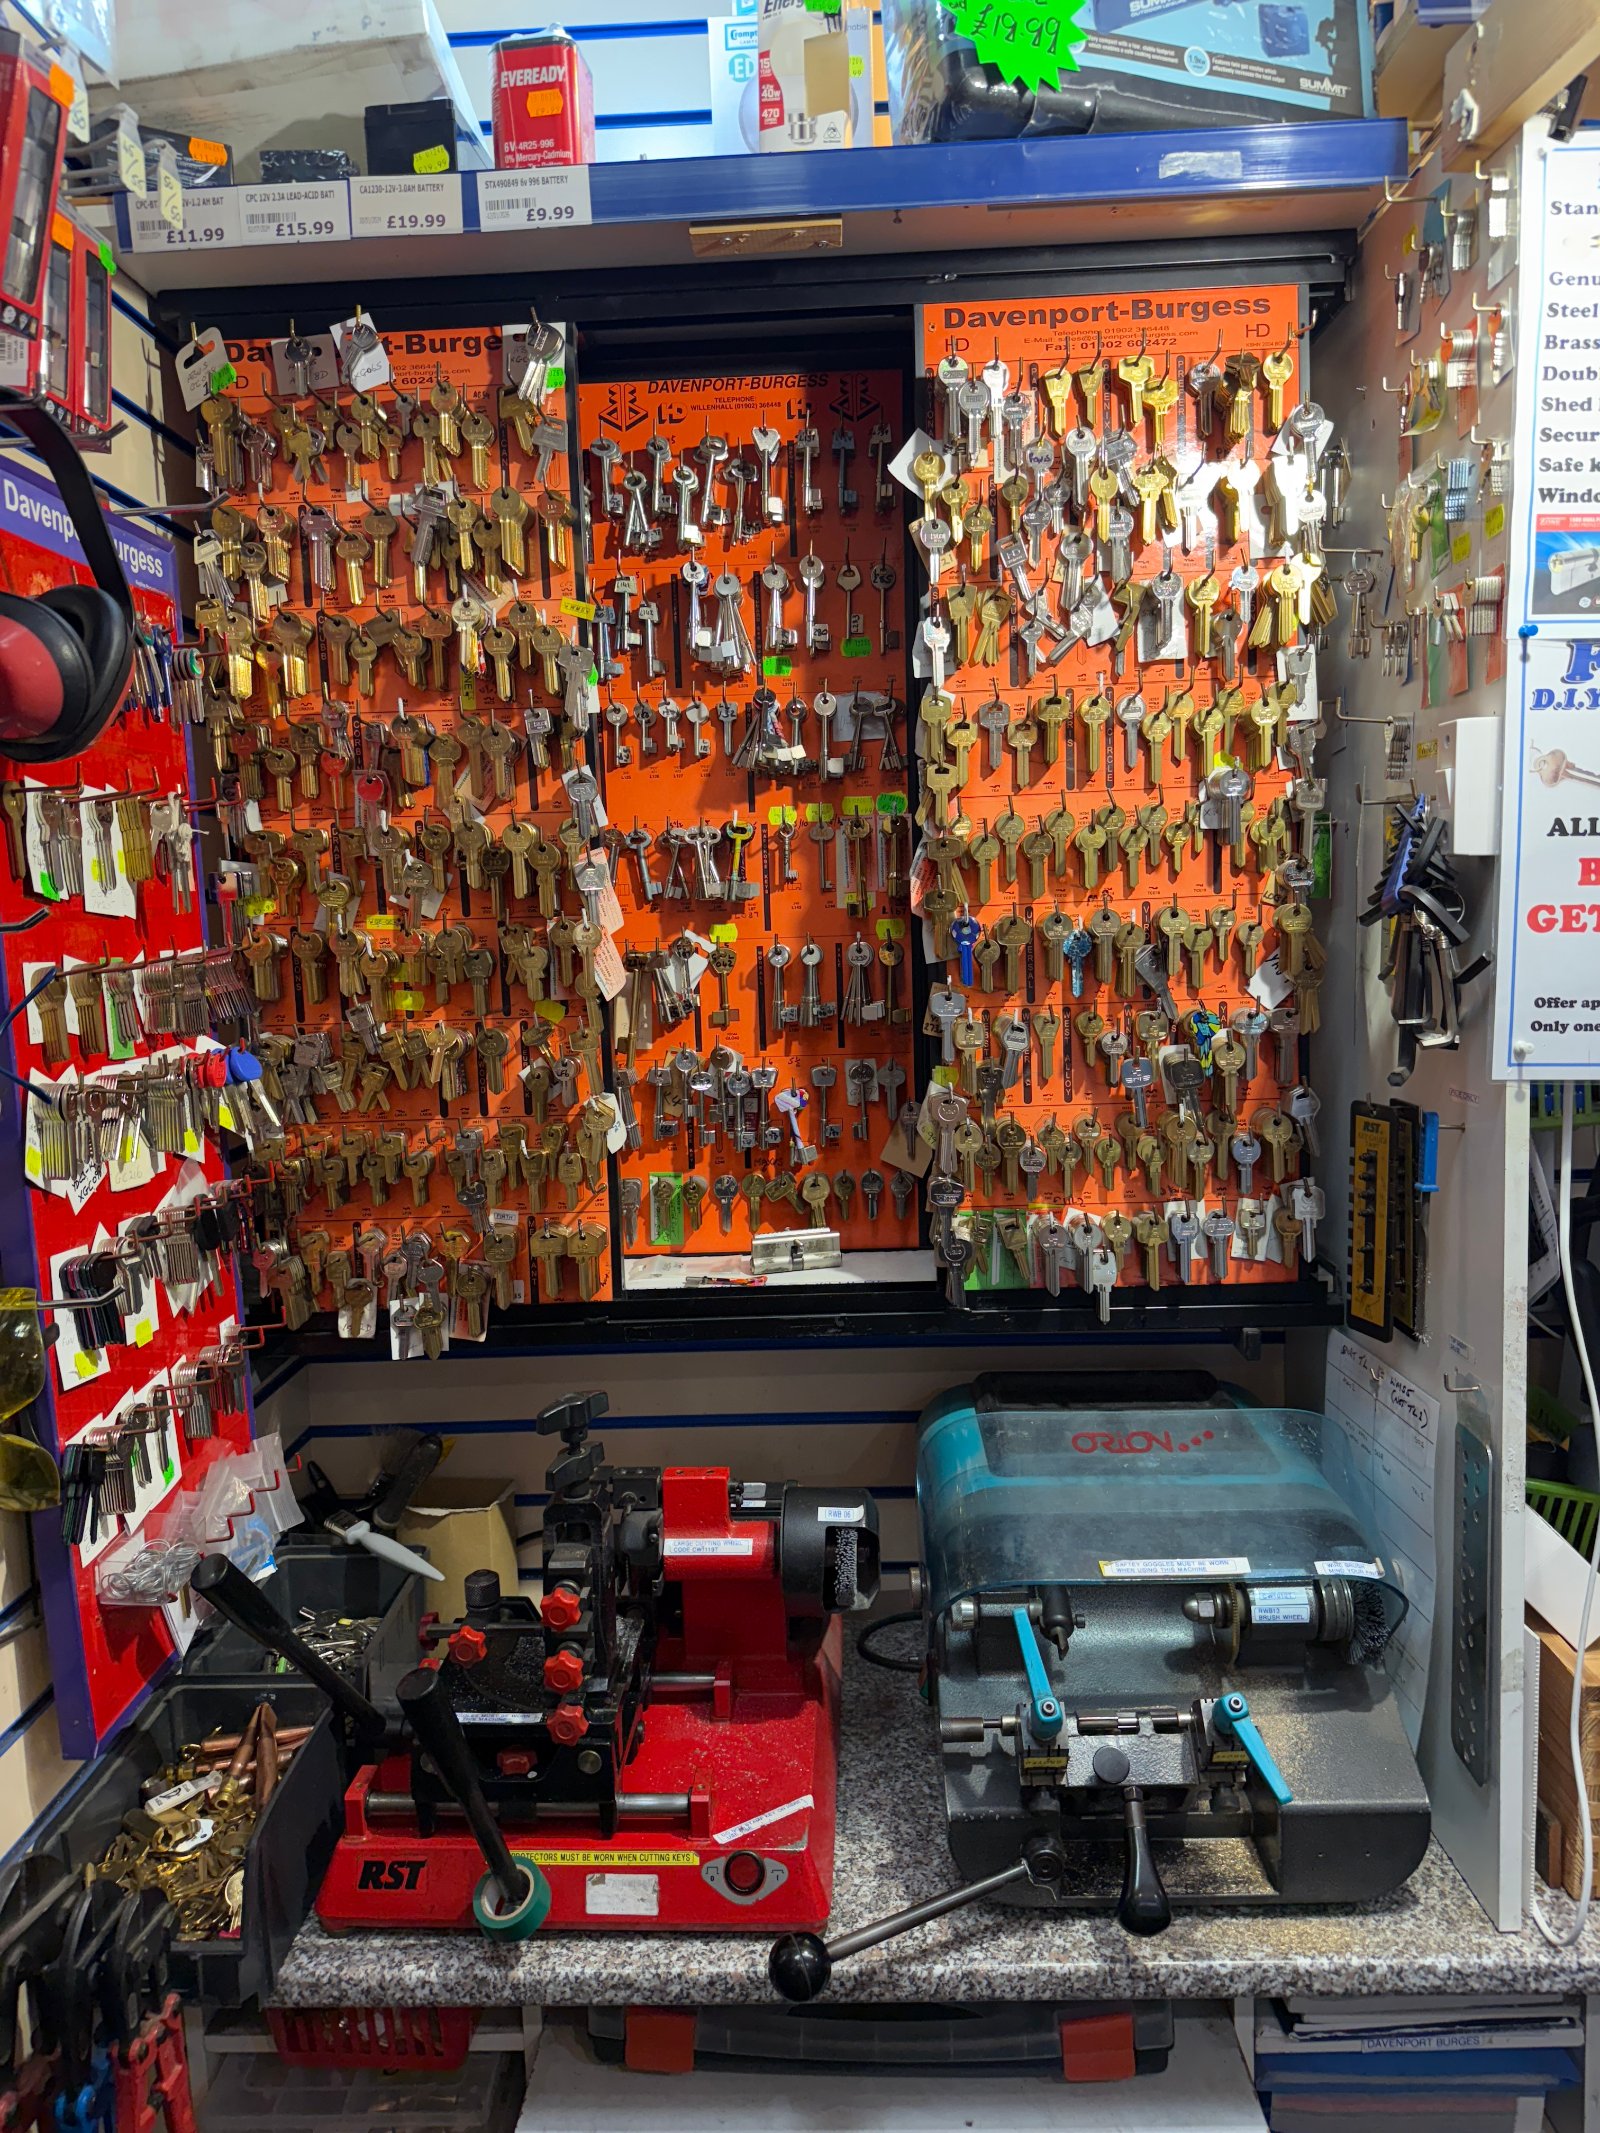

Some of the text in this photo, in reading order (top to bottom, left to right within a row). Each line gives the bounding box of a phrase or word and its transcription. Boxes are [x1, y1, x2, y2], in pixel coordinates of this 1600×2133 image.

[971, 3, 1061, 55] £19.99
[501, 65, 566, 89] EVEREADY
[1300, 77, 1348, 94] SUMMIT
[762, 108, 780, 118] 470
[516, 149, 572, 162] Mercury-Cadmium
[418, 183, 444, 193] BATTERY
[541, 175, 569, 186] BATTERY
[246, 194, 259, 203] CPC
[286, 191, 318, 200] LEAD-ACID
[387, 214, 446, 229] £19.99
[526, 206, 575, 222] £9.99
[166, 228, 225, 244] £11.99
[276, 221, 335, 237] £15.99
[944, 297, 1271, 330] Davenport-Burgess
[1546, 303, 1599, 318] Steel
[1246, 323, 1270, 339] HD
[944, 338, 970, 352] HD
[647, 374, 829, 395] DAVENPORT-BURGESS
[690, 403, 734, 411] WILLENHALL
[1541, 397, 1593, 412] Shed
[1538, 457, 1584, 473] Safe
[1534, 996, 1578, 1011] Offer
[1531, 1019, 1563, 1034] Only
[1071, 1430, 1174, 1454] ORION
[560, 1853, 579, 1862] MUST
[582, 1853, 591, 1862] BE
[593, 1853, 615, 1862] WORN
[617, 1853, 637, 1862] WHEN
[639, 1853, 670, 1862] CUTTING
[672, 1853, 691, 1862] KEYS
[357, 1860, 429, 1891] RST
[1367, 2035, 1480, 2049] DAVENPORT BURGES
